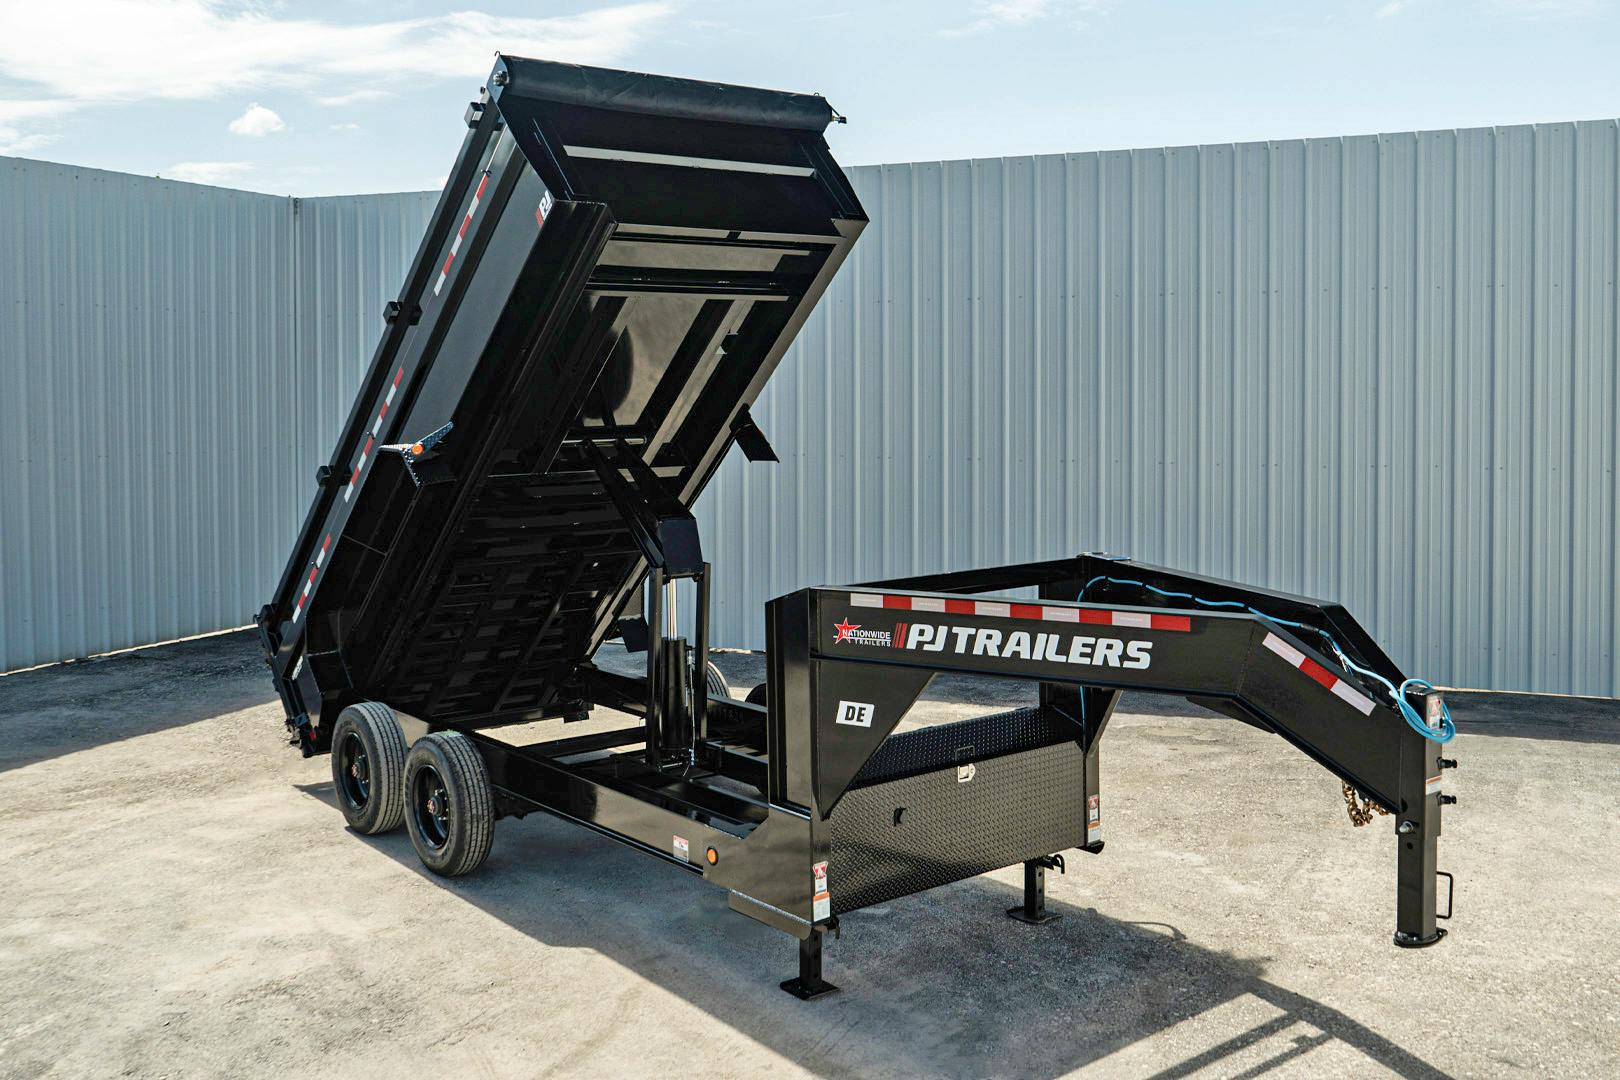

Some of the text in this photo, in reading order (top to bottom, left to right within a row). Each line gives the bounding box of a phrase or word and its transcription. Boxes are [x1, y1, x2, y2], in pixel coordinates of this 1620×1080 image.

[842, 629, 890, 639] NATIONWIDE
[855, 639, 890, 647] TRAILERS
[906, 623, 1153, 669] PJ TRAILERS
[844, 705, 866, 723] DE
